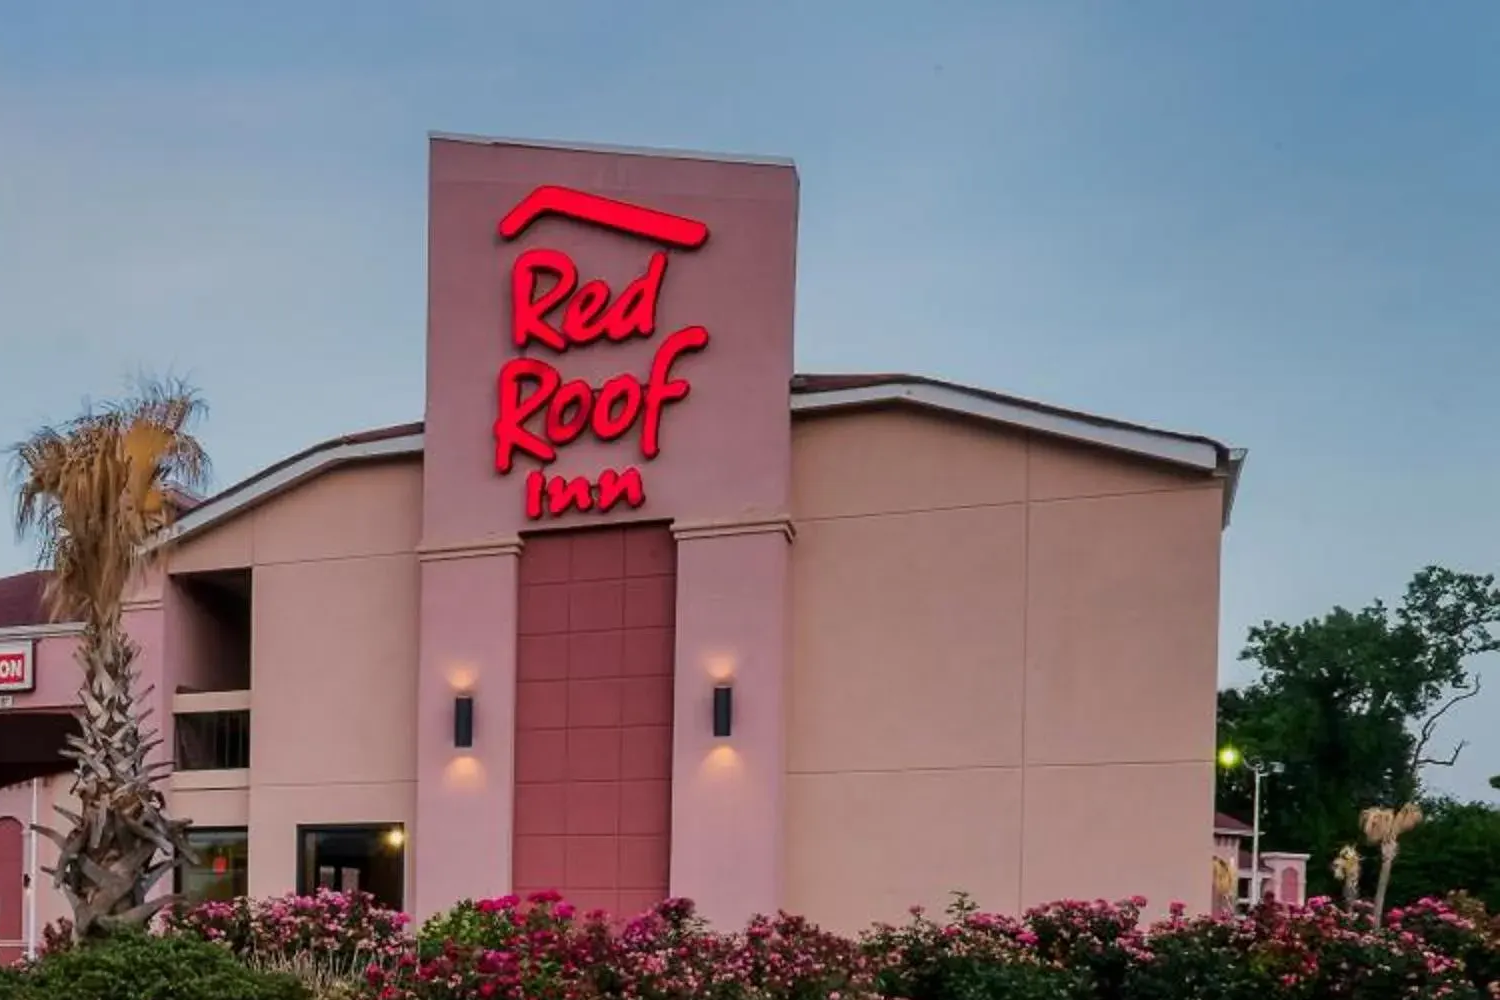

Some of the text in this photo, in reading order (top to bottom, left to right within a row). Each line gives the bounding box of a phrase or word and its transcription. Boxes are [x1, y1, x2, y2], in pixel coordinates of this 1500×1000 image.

[513, 248, 668, 349] Red
[495, 326, 708, 473] Roof
[525, 466, 646, 519] Inn
